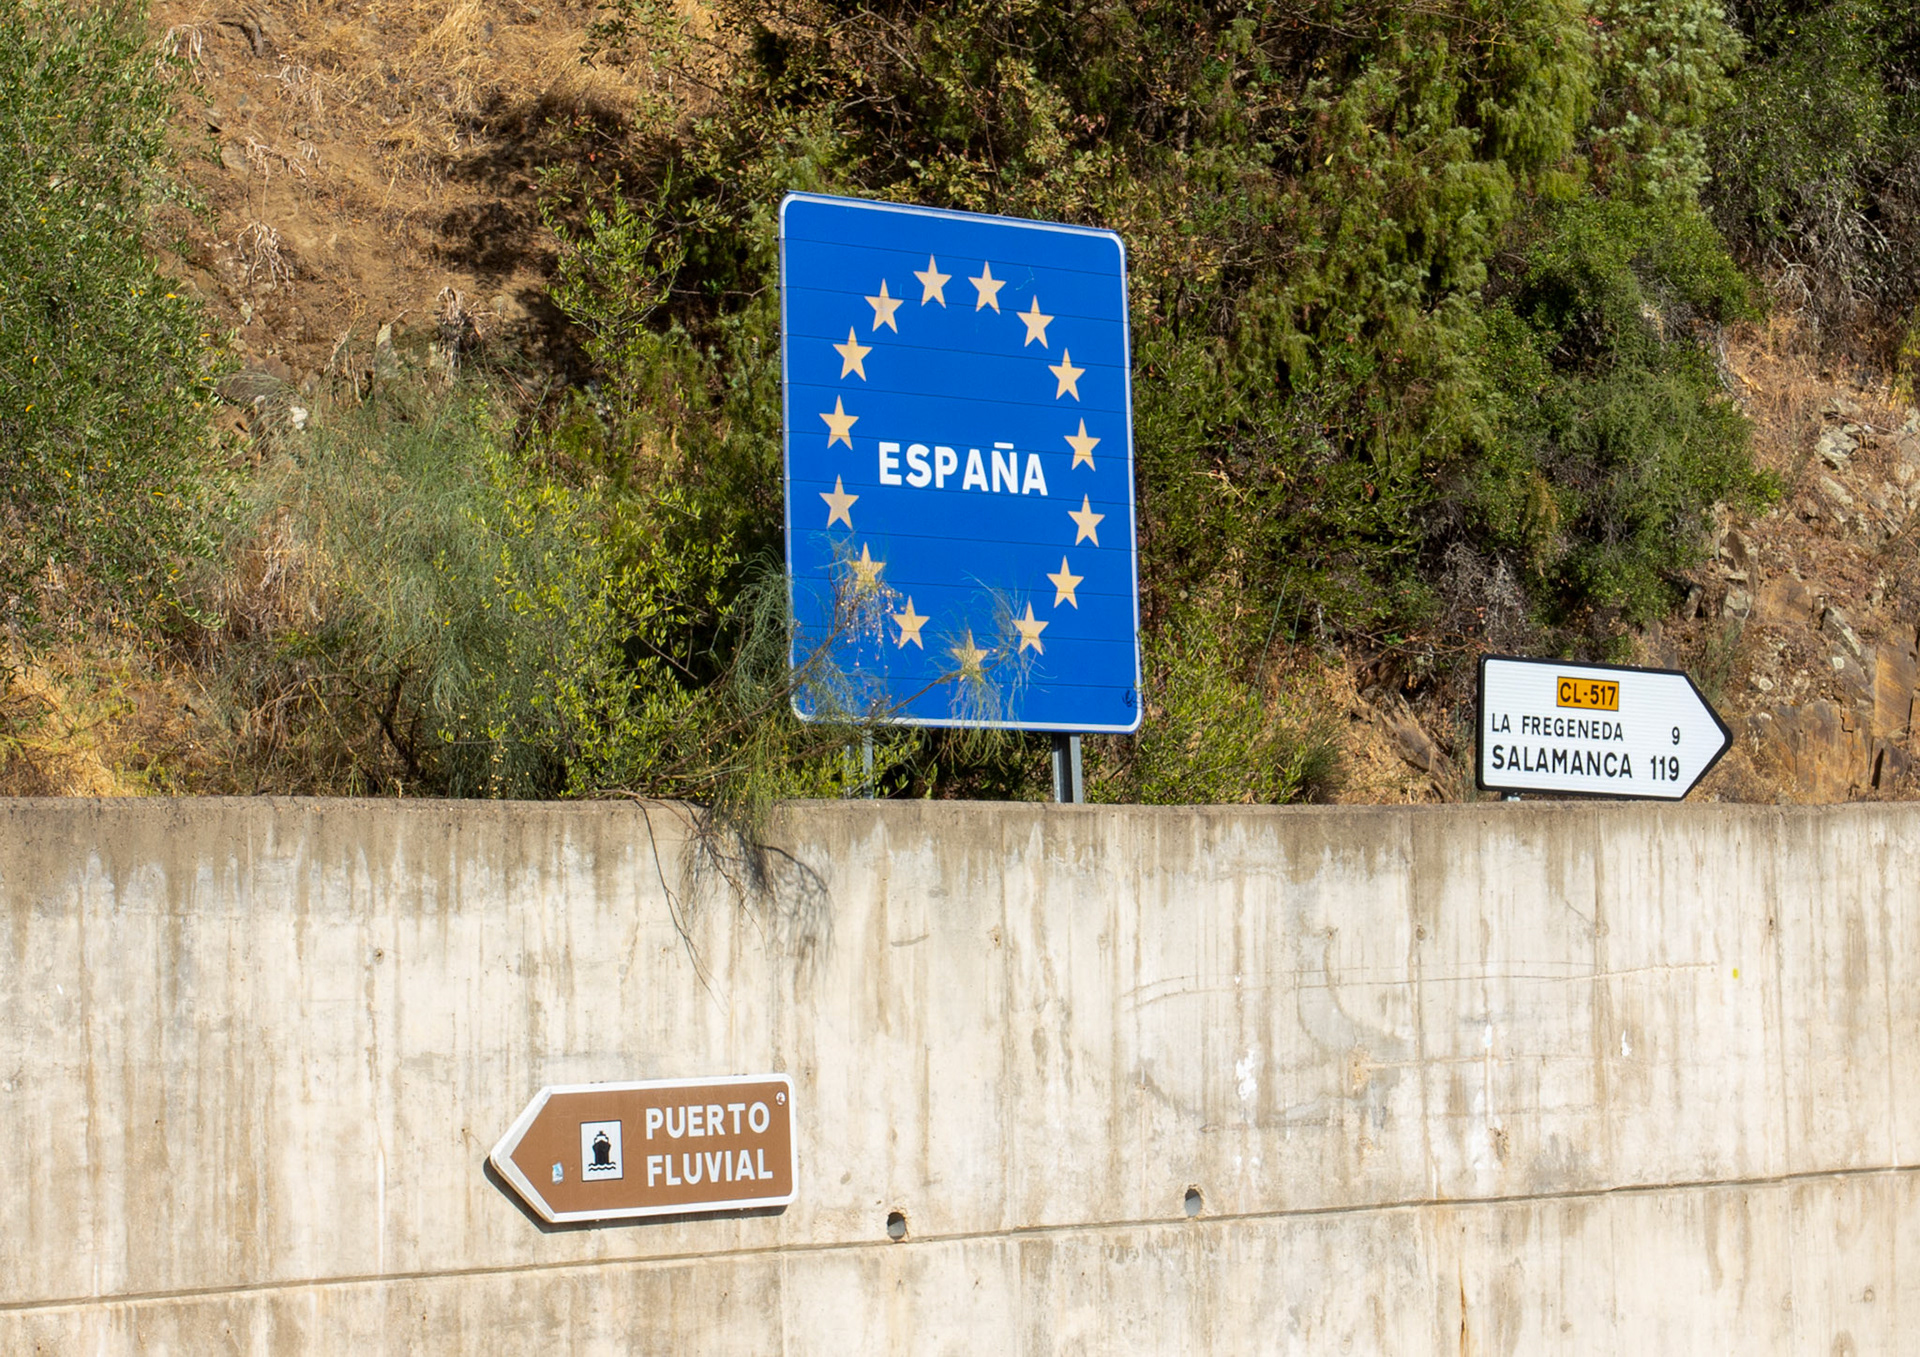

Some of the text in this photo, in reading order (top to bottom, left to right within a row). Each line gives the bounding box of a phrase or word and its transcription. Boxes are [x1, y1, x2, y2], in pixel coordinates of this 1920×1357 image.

[879, 441, 1048, 496] ESPAÑA
[1559, 682, 1617, 706] CL-517
[1491, 713, 1681, 745] LA FREGENEDA 9
[1492, 744, 1680, 781] SALAMANCA 119
[646, 1101, 770, 1140] PUERTO
[647, 1148, 773, 1187] FLUVIAL
